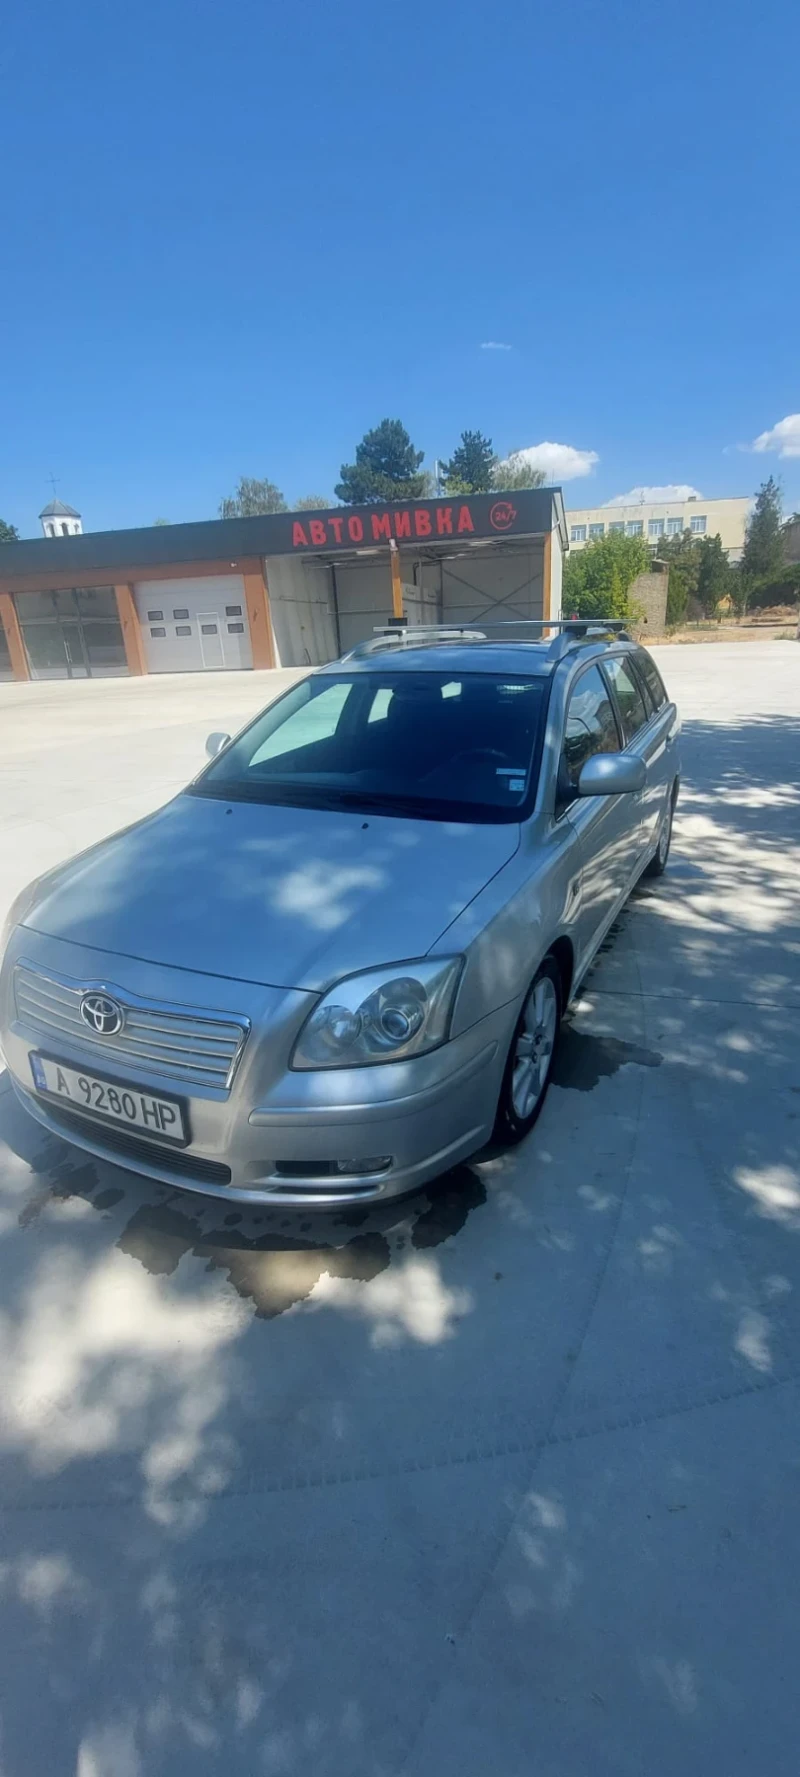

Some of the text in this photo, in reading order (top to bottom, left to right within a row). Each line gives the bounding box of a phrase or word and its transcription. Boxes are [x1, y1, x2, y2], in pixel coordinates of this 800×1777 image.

[495, 510, 517, 522] 24/7
[56, 1067, 71, 1095] A
[77, 1077, 137, 1120] 9280
